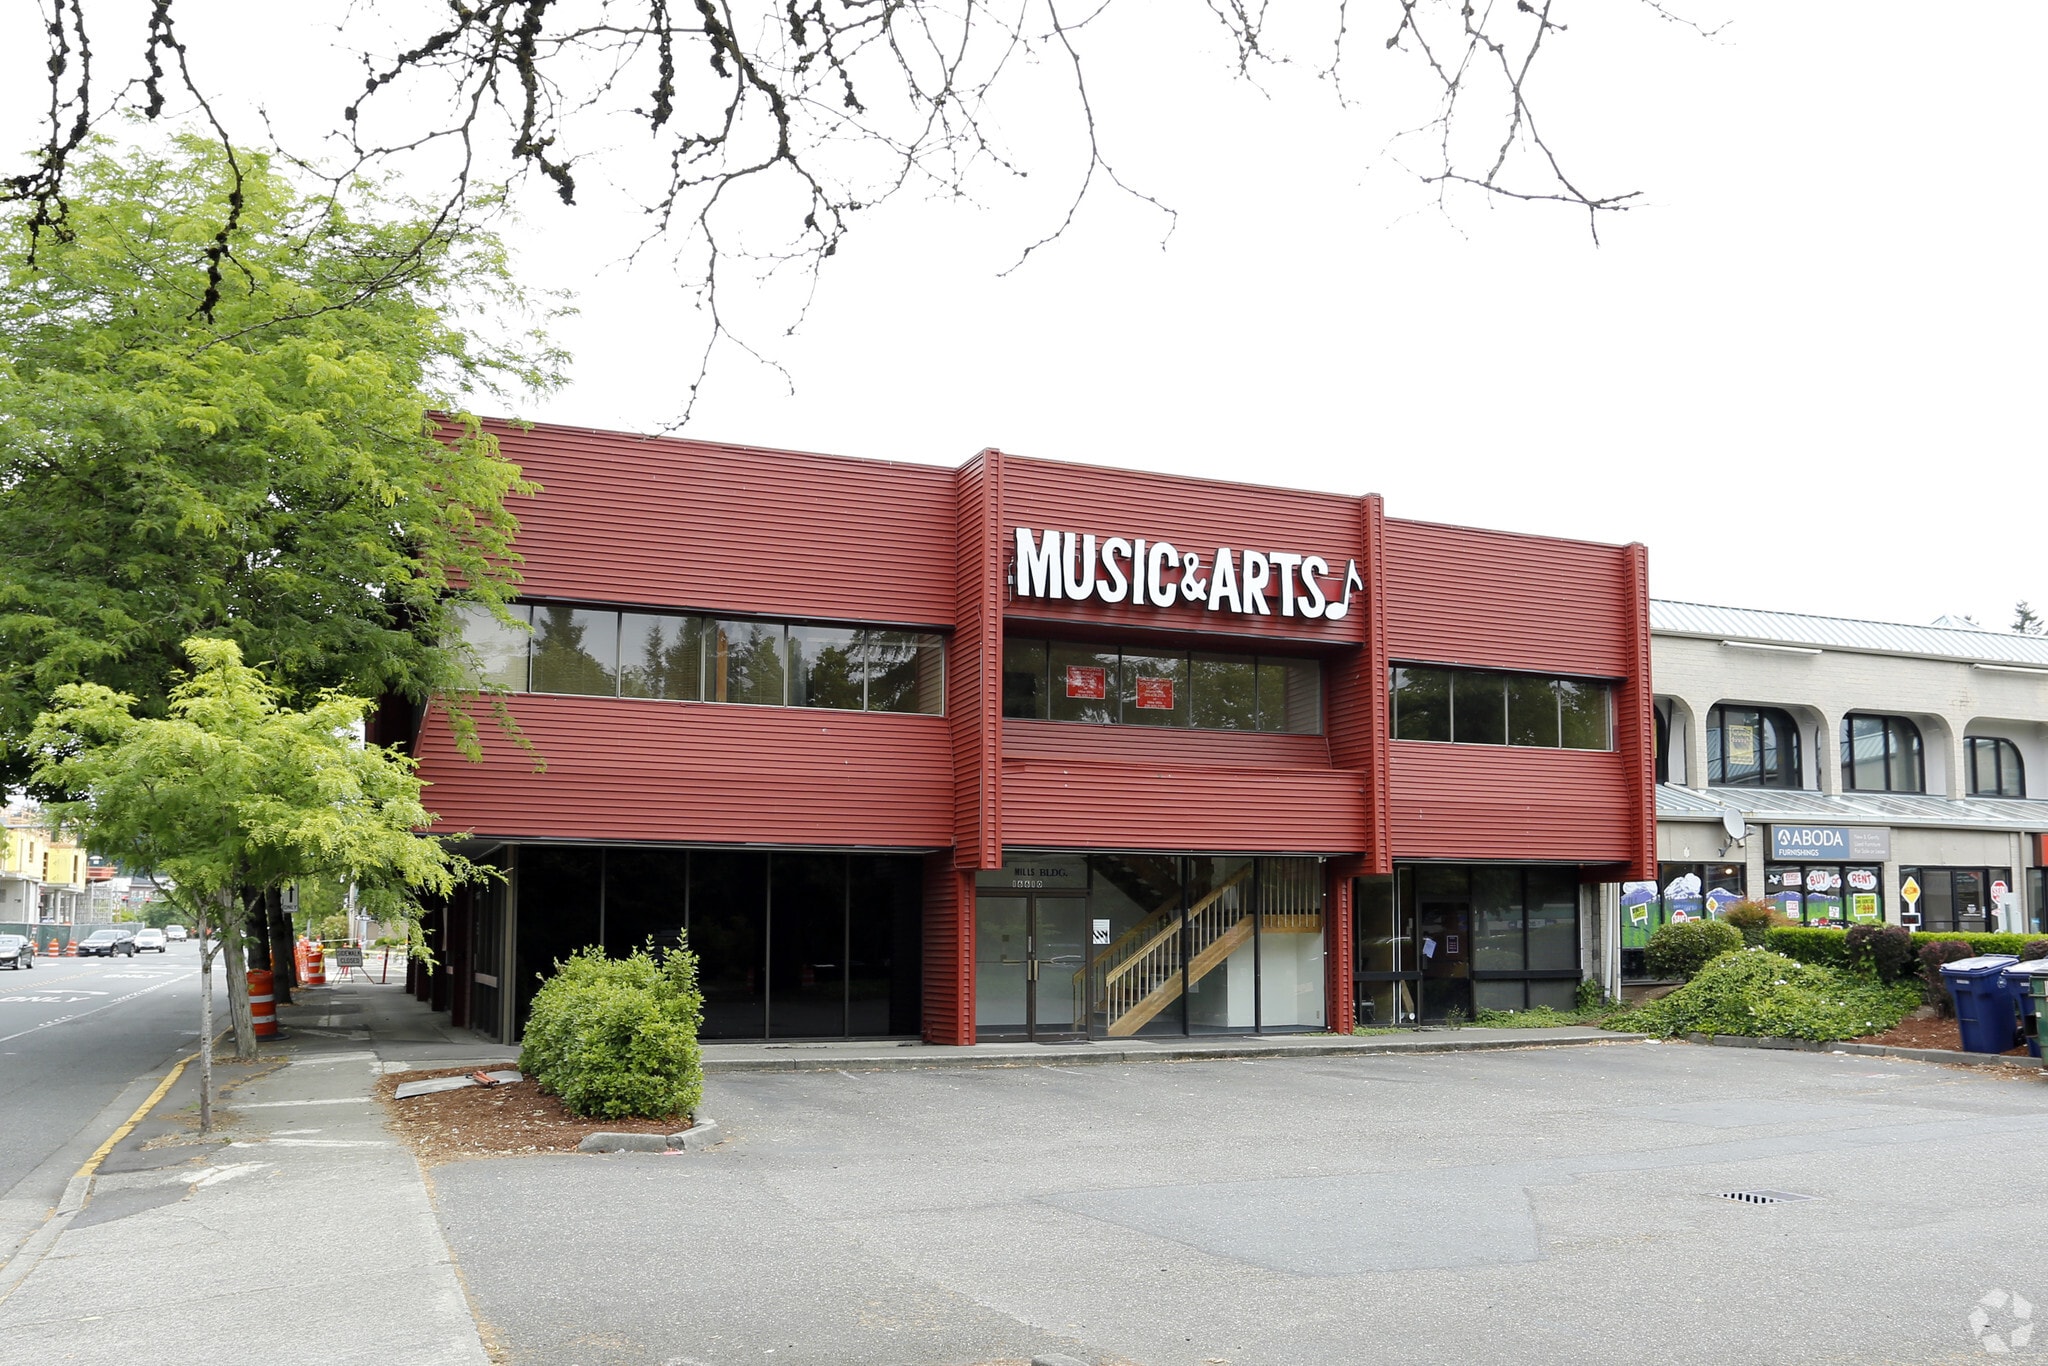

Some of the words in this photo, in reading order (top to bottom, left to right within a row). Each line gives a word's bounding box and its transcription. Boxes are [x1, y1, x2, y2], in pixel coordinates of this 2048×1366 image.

[1791, 829, 1844, 846] ABODA
[1778, 848, 1819, 857] FURNISHINGS
[1014, 867, 1035, 876] MILLS
[1040, 868, 1068, 877] BLDG.
[1809, 873, 1826, 886] BUY
[1851, 873, 1872, 885] RENT
[337, 949, 361, 957] SIDEWALK
